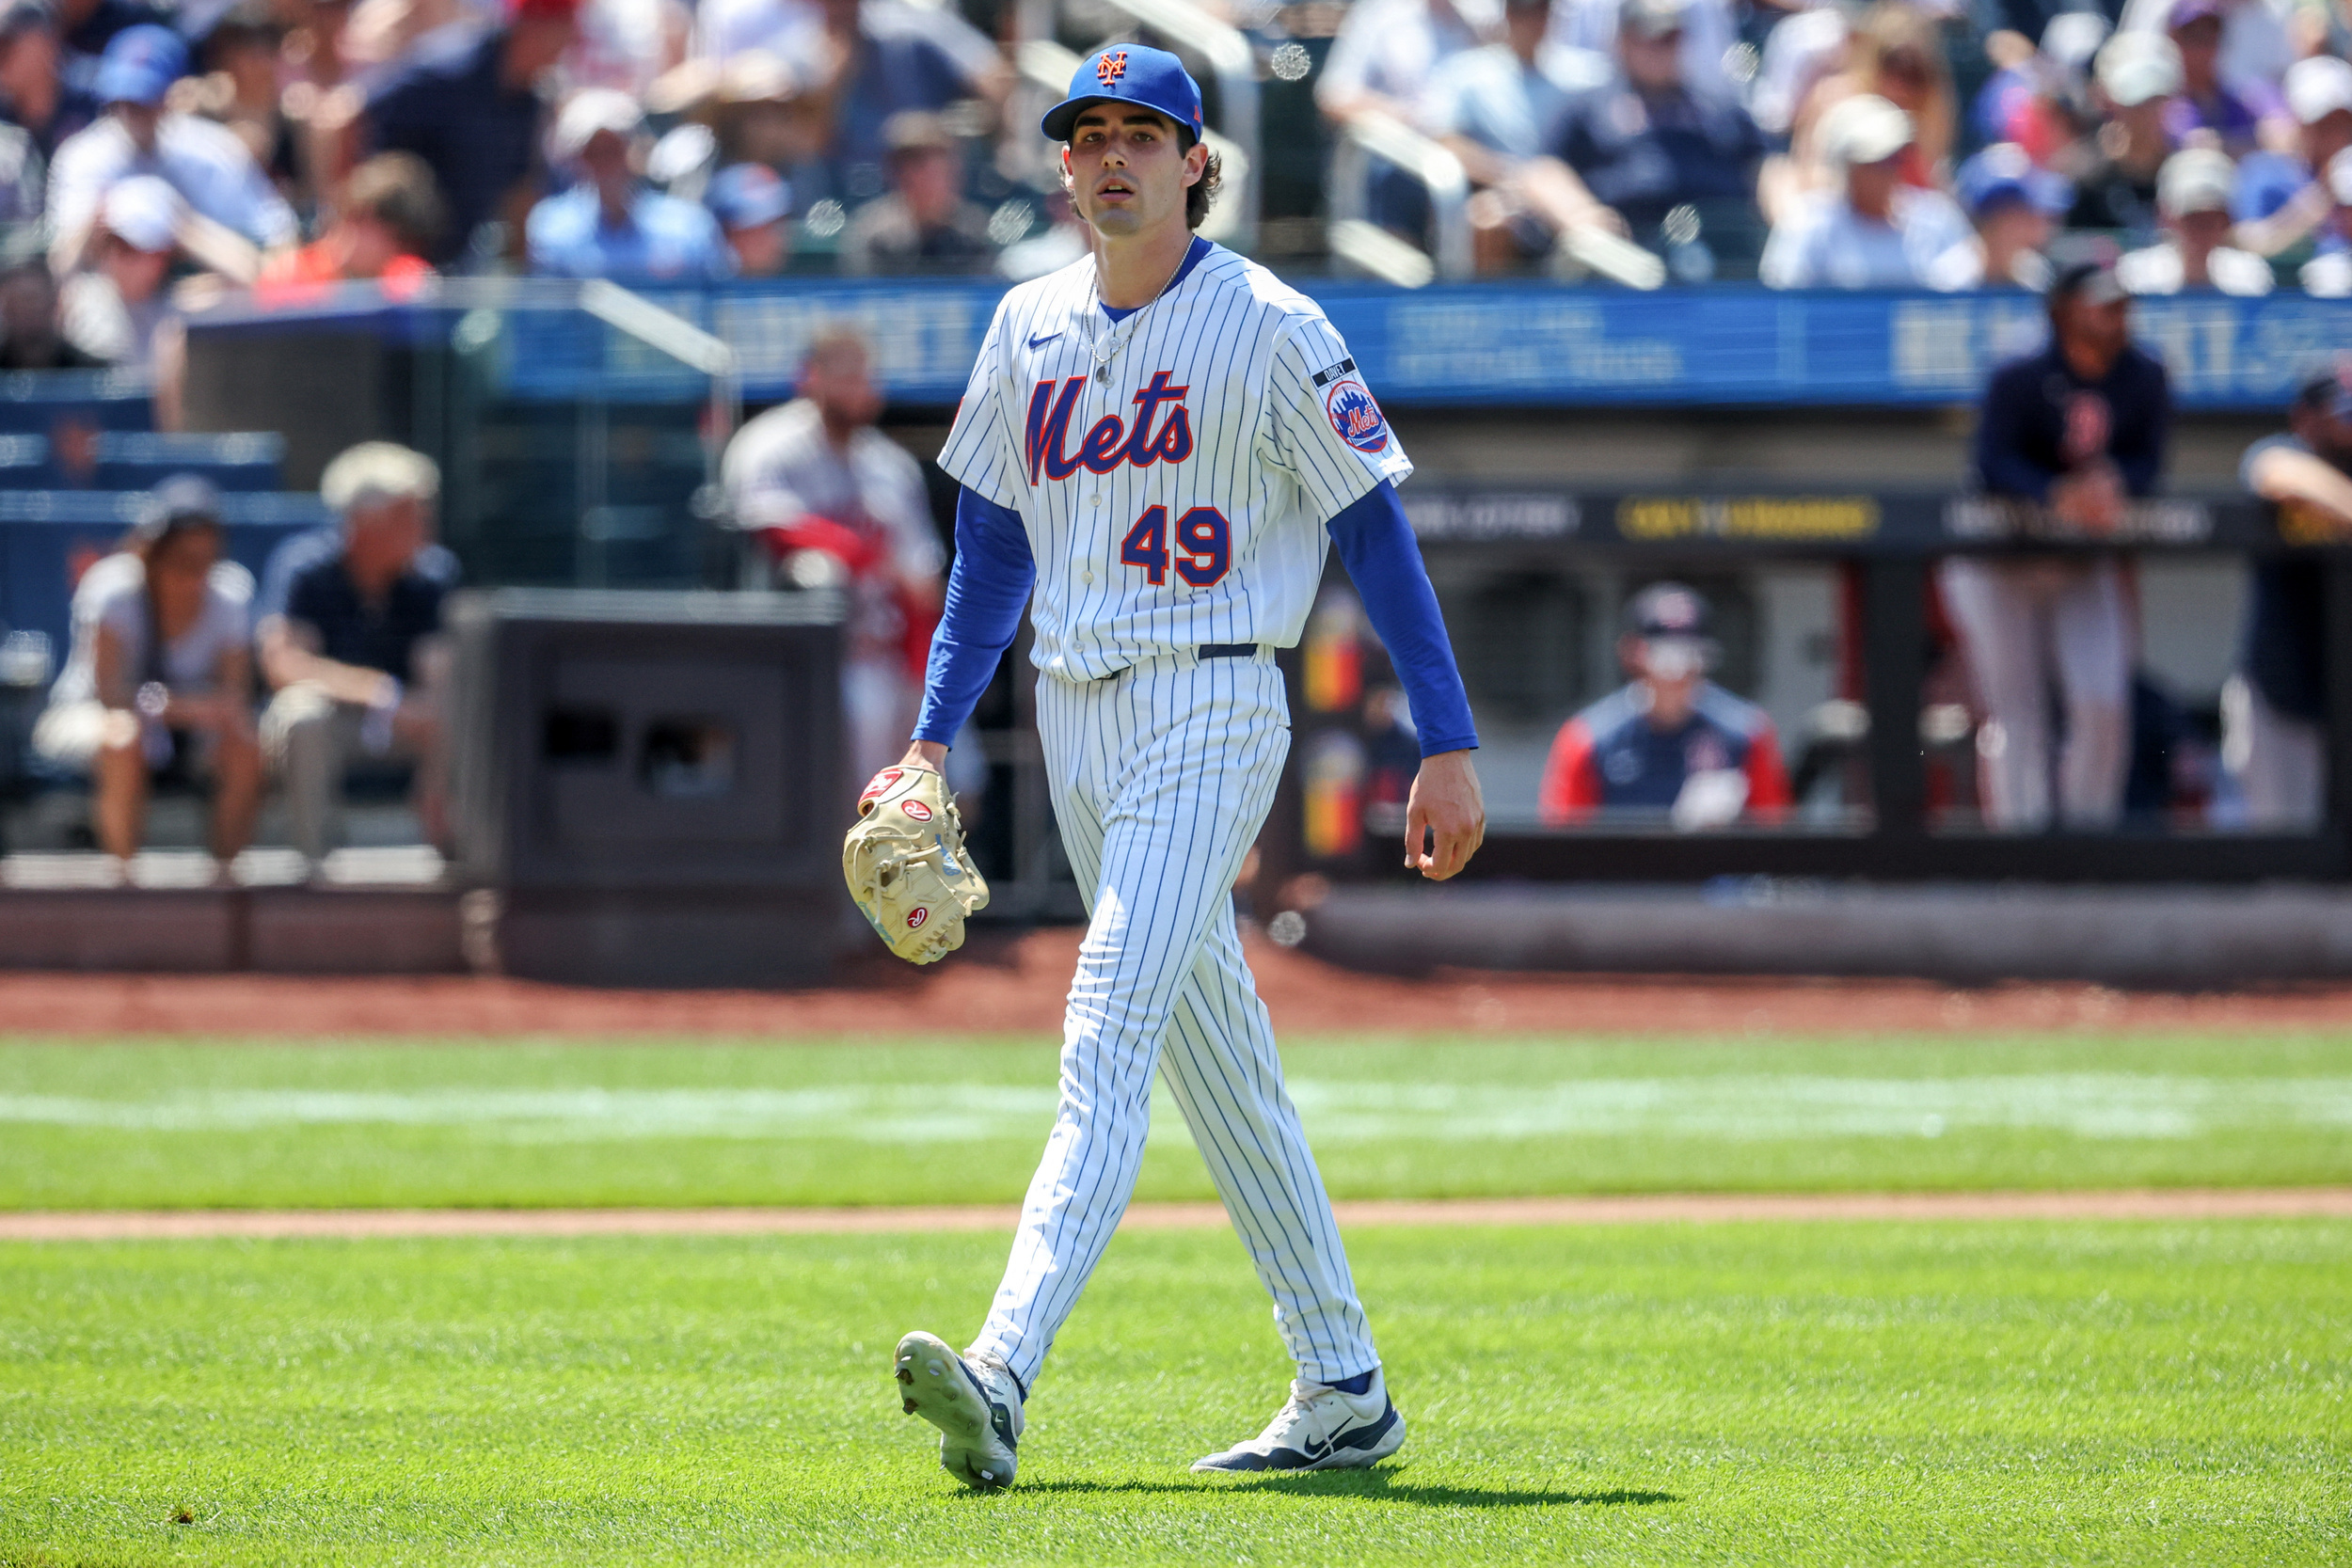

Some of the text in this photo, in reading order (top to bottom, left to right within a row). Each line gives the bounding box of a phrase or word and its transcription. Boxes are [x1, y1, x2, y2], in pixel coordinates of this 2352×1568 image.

[1324, 362, 1345, 381] DAVEY
[1025, 371, 1193, 486] Mets
[1348, 405, 1379, 436] Mets
[1120, 504, 1232, 587] 49
